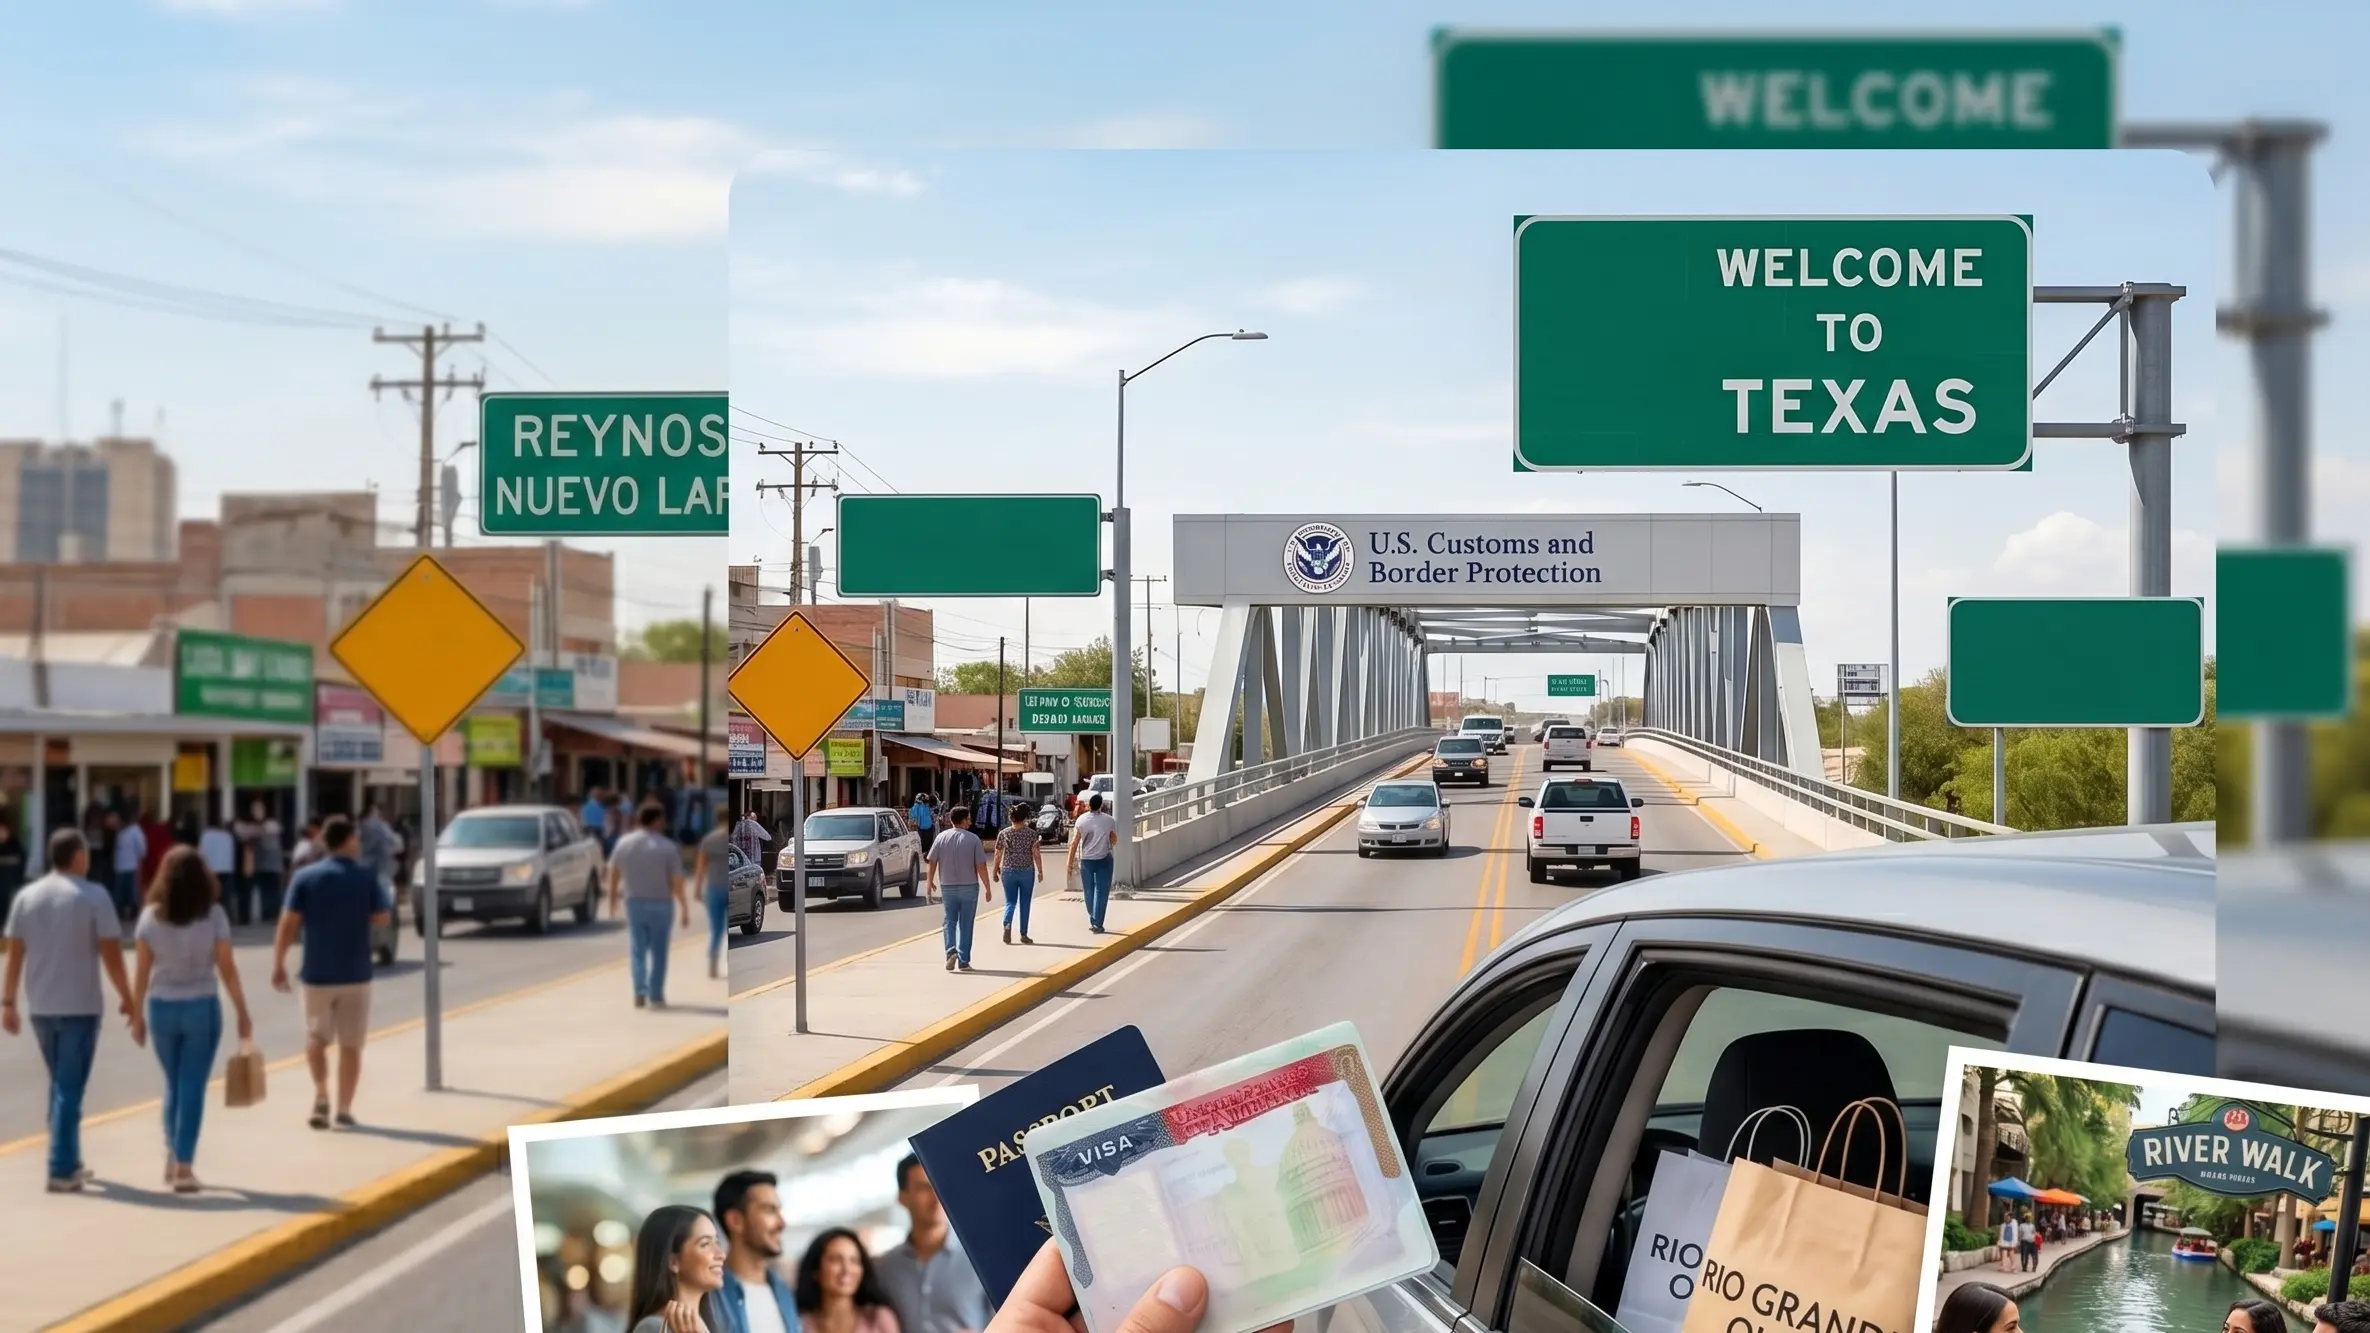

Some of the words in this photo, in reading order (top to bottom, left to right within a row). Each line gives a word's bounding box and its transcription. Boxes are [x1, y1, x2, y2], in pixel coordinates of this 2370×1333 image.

[1698, 70, 2053, 130] WELCOME
[1716, 247, 1983, 287] WELCOME
[1816, 312, 1883, 352] TO
[1722, 378, 1977, 435] TEXAS
[514, 413, 727, 457] REYNOS
[496, 476, 639, 516] NUEVO
[1369, 532, 1418, 555] U.S.
[1427, 532, 1540, 555] Customs
[1548, 531, 1594, 554] and
[1369, 560, 1459, 584] Border
[1466, 561, 1602, 584] Protection
[1078, 1135, 1133, 1165] VISA
[2143, 1134, 2230, 1167] RIVER
[2241, 1138, 2323, 1190] WALK
[1650, 1233, 1703, 1269] RIO
[1702, 1259, 1745, 1301] RIO
